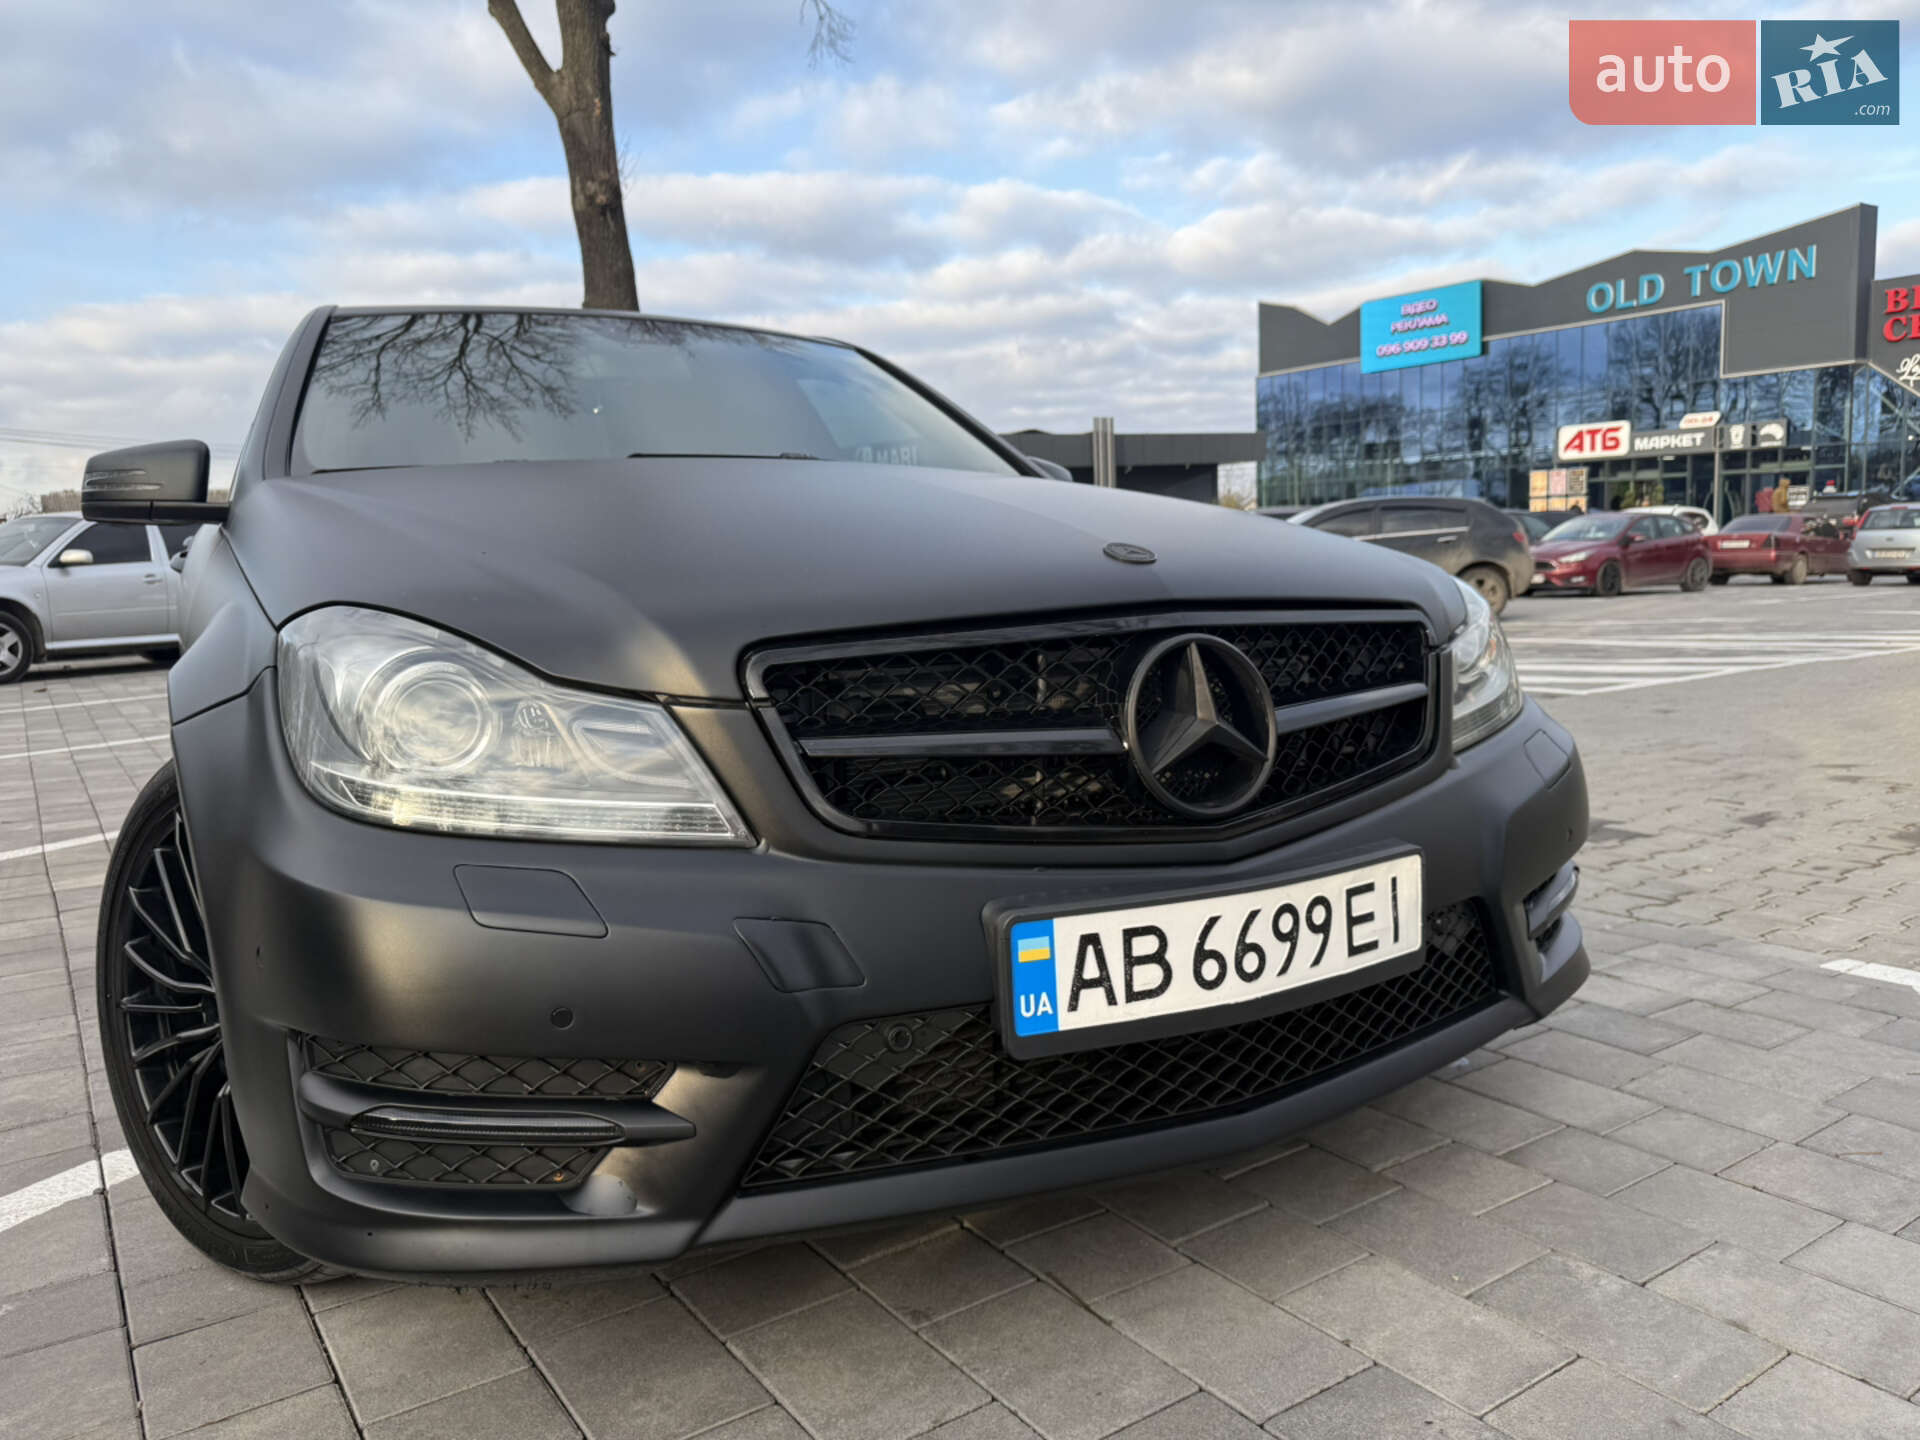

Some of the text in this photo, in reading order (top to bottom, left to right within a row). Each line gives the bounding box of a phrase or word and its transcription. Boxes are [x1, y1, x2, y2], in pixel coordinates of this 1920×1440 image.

[1586, 244, 1817, 313] OLD TOWN
[1376, 344, 1402, 357] 096
[1403, 339, 1430, 352] 909
[1564, 426, 1705, 453] АТБ МАРКЕТ
[1067, 876, 1400, 1012] AB 6699 EI
[1020, 994, 1053, 1018] UA
